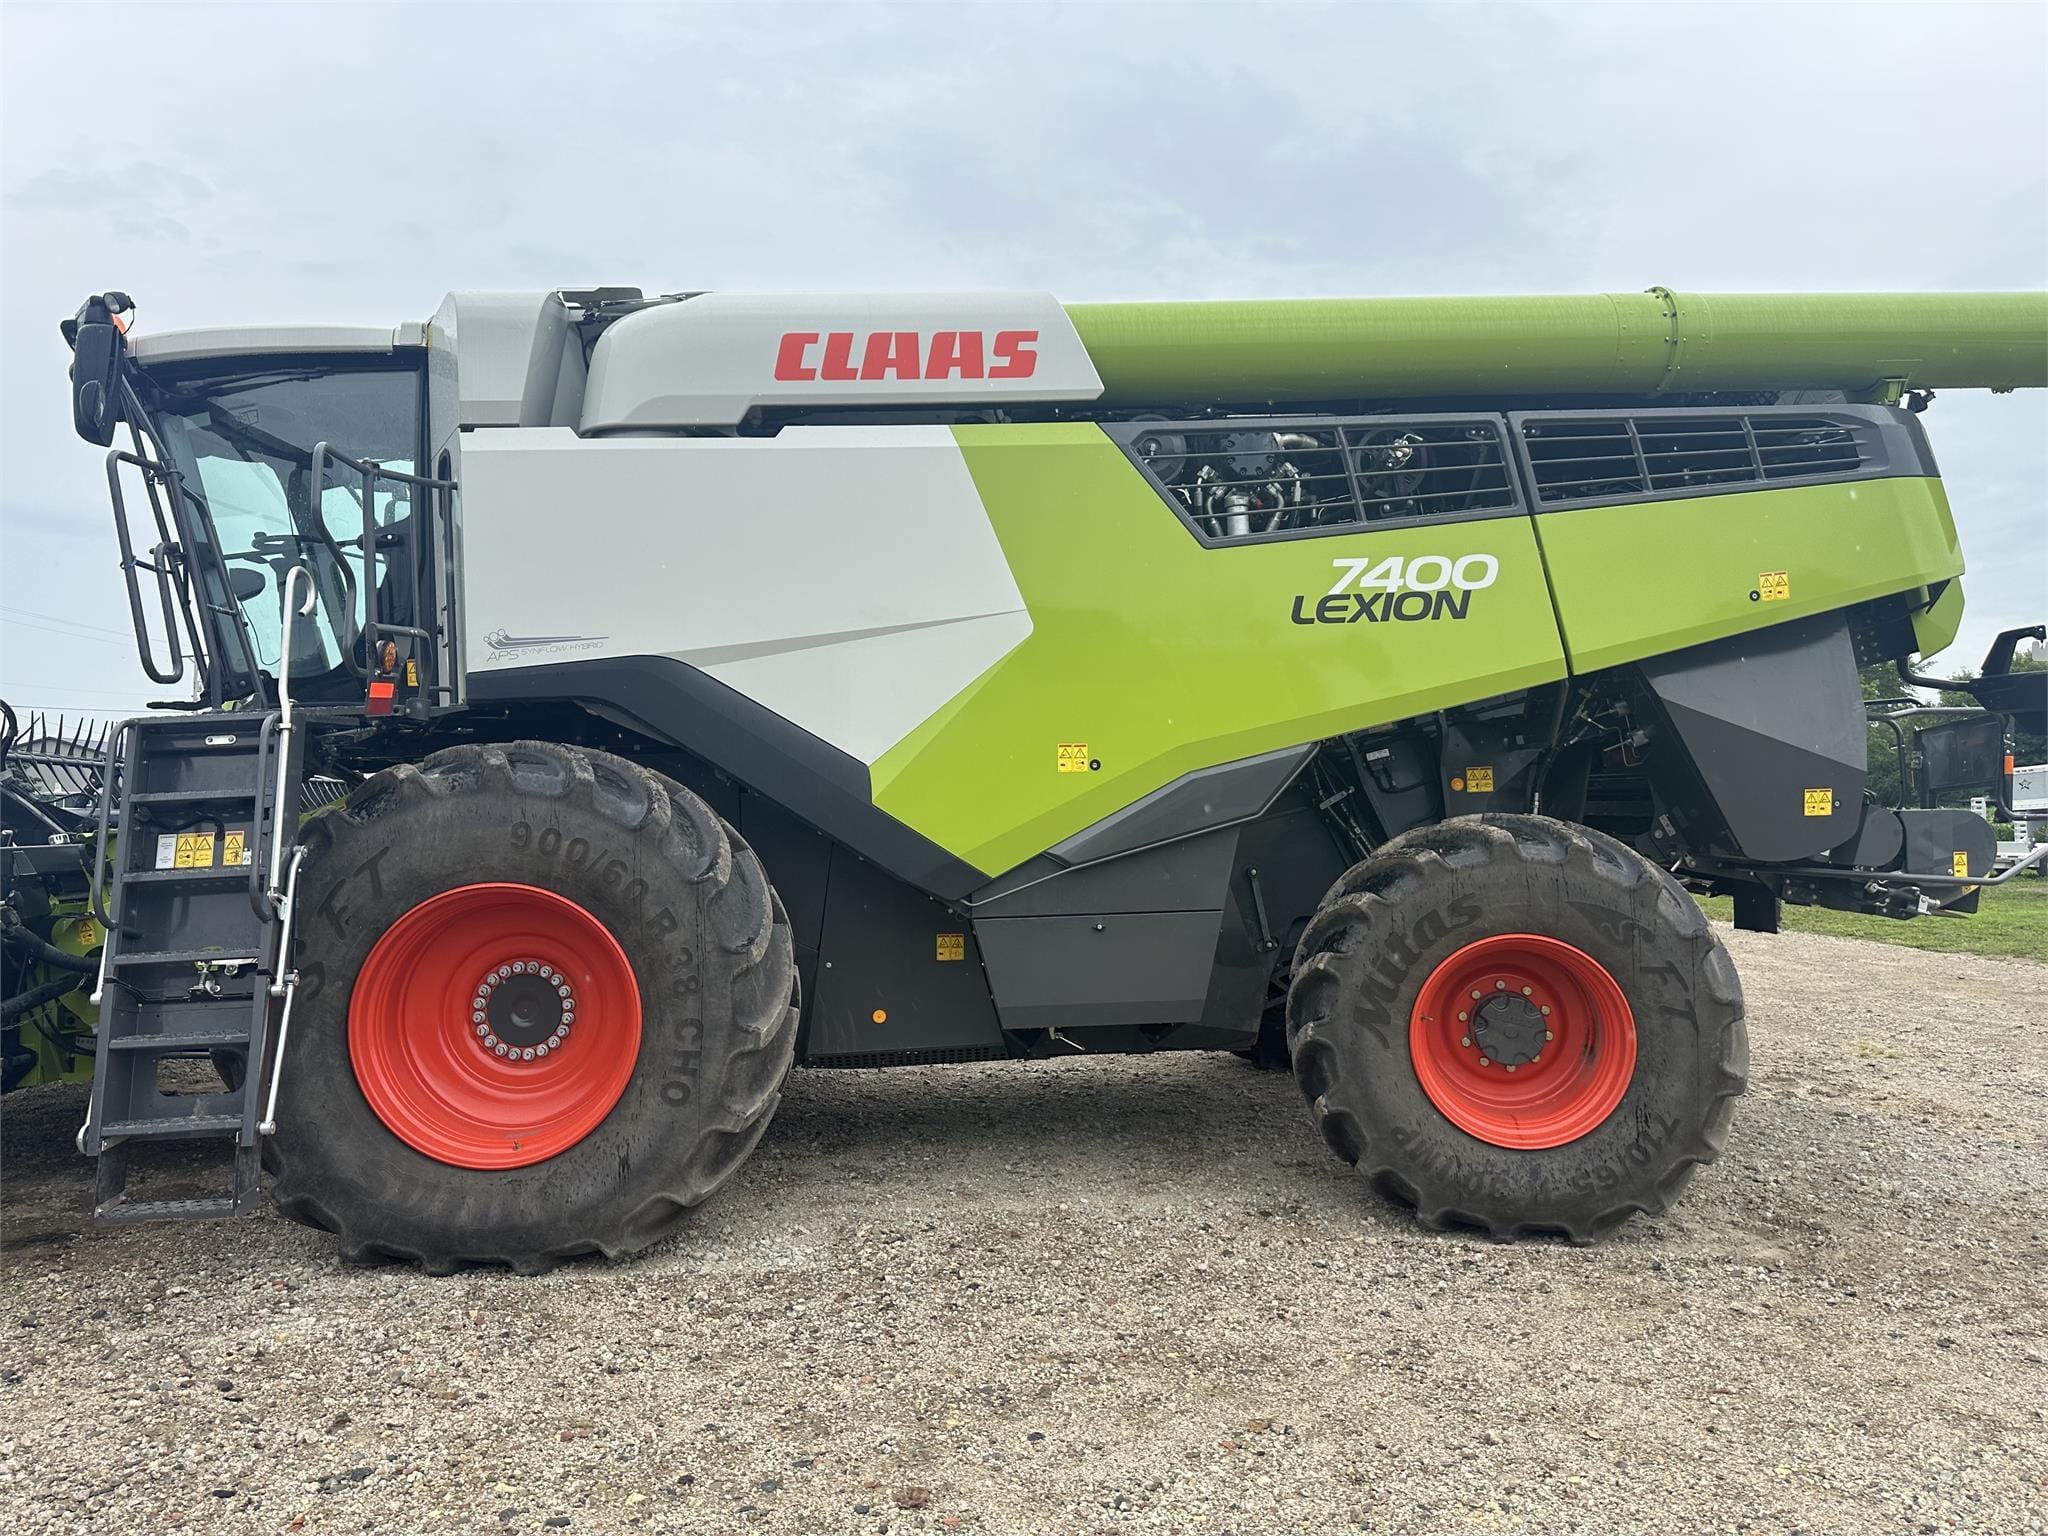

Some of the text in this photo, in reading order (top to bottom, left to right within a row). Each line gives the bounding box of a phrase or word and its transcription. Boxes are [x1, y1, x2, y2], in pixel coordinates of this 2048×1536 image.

[774, 331, 1039, 381] CLAAS
[1328, 554, 1499, 596] 7400
[1291, 590, 1472, 625] LEXION
[486, 650, 519, 662] APS
[510, 821, 650, 900] 900/60
[1353, 893, 1482, 1049] Mitas
